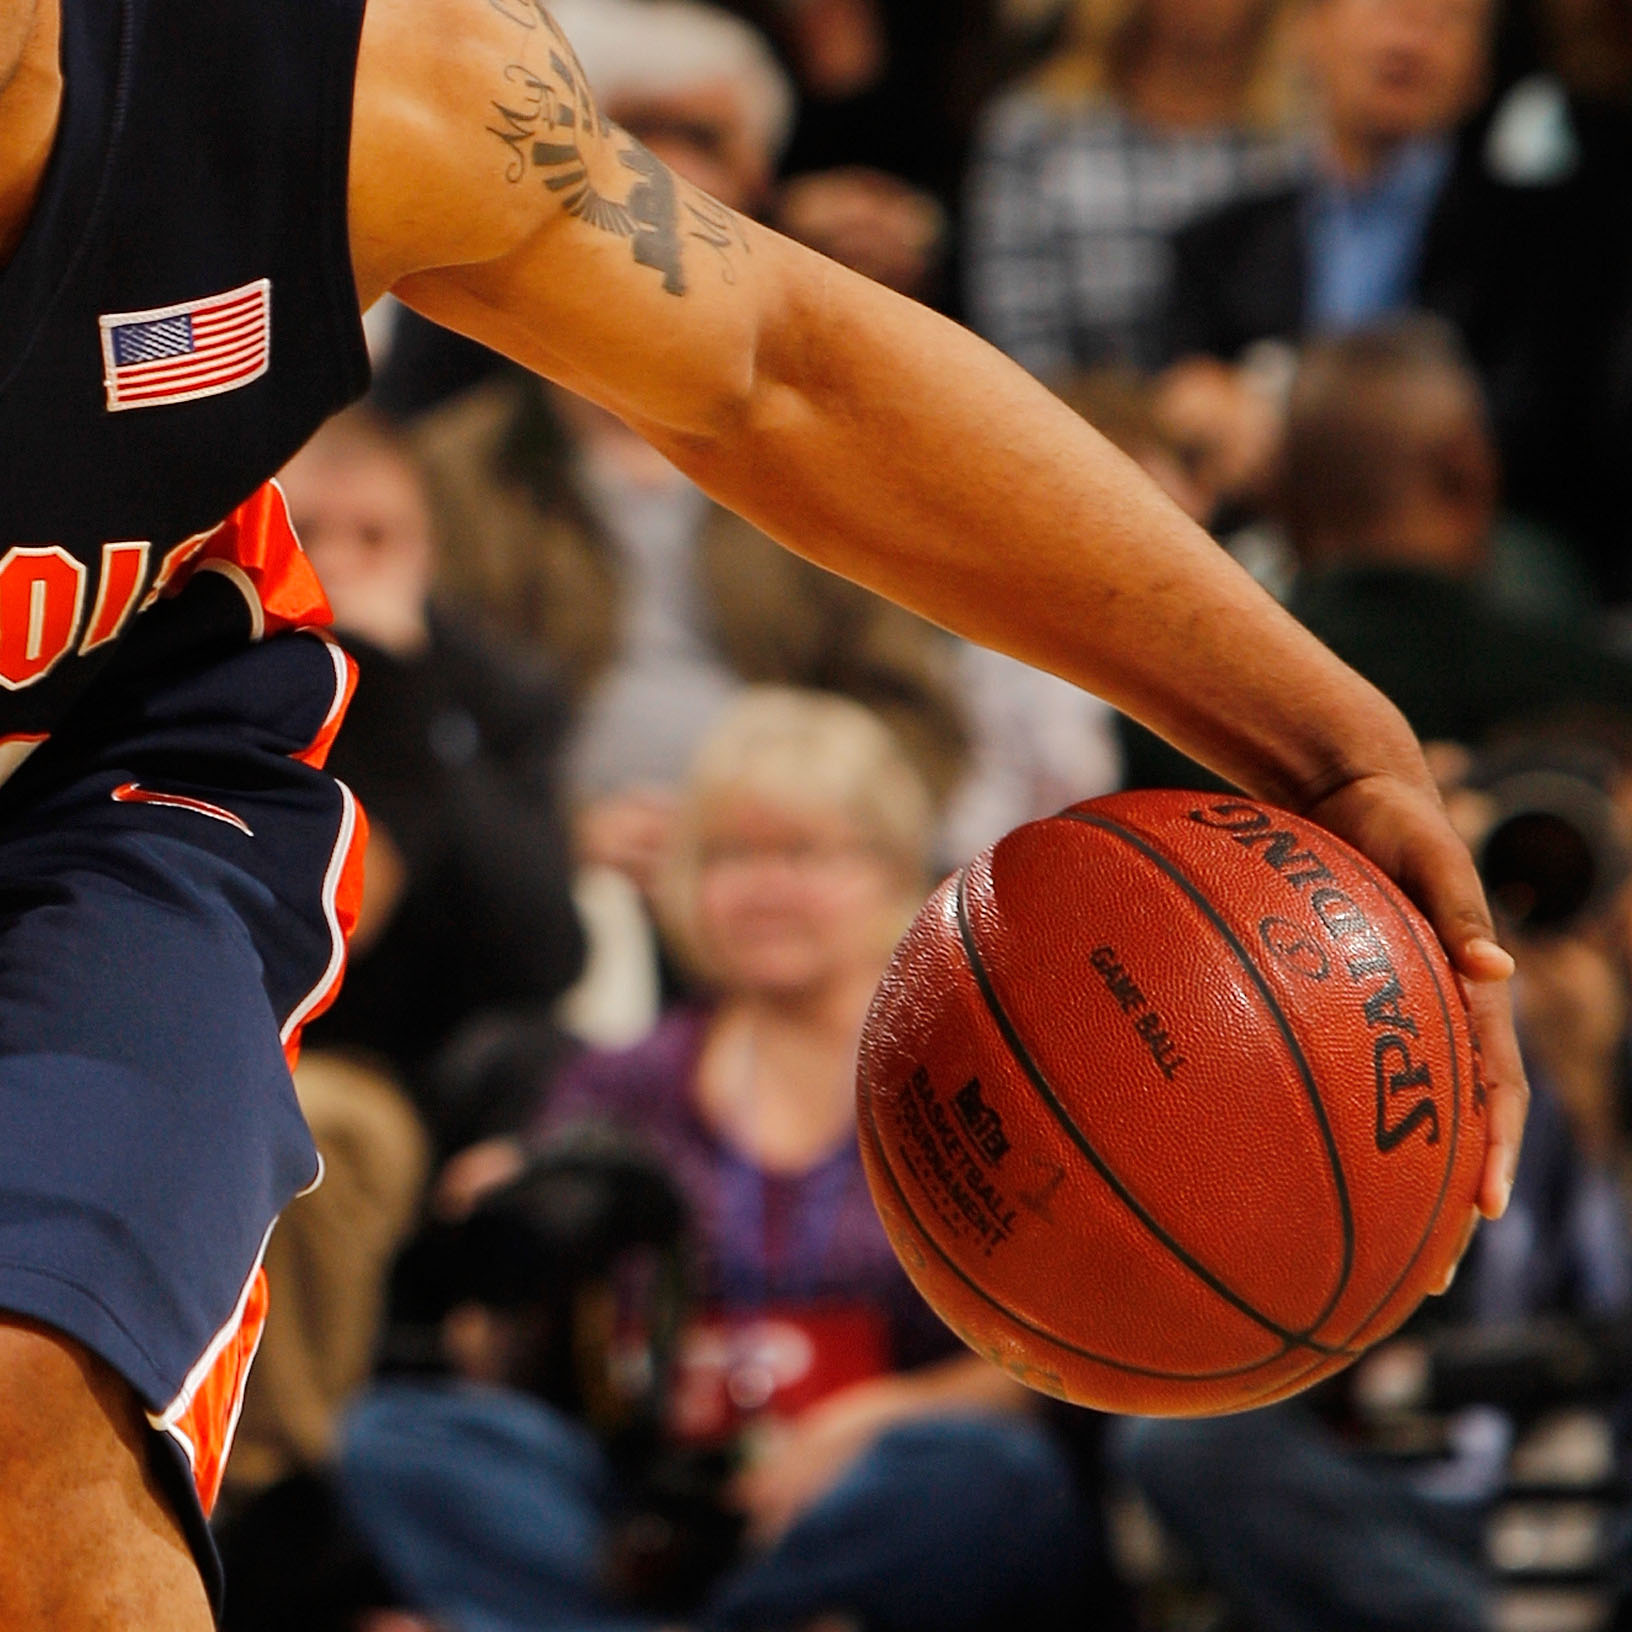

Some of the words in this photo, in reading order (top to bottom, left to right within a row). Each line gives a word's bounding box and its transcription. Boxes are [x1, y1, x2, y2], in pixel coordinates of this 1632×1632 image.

[1089, 945, 1147, 1014] GAME
[1134, 1011, 1187, 1081] BALL
[1189, 802, 1441, 1153] SPALDING
[911, 1065, 1018, 1234] BASKETBALL
